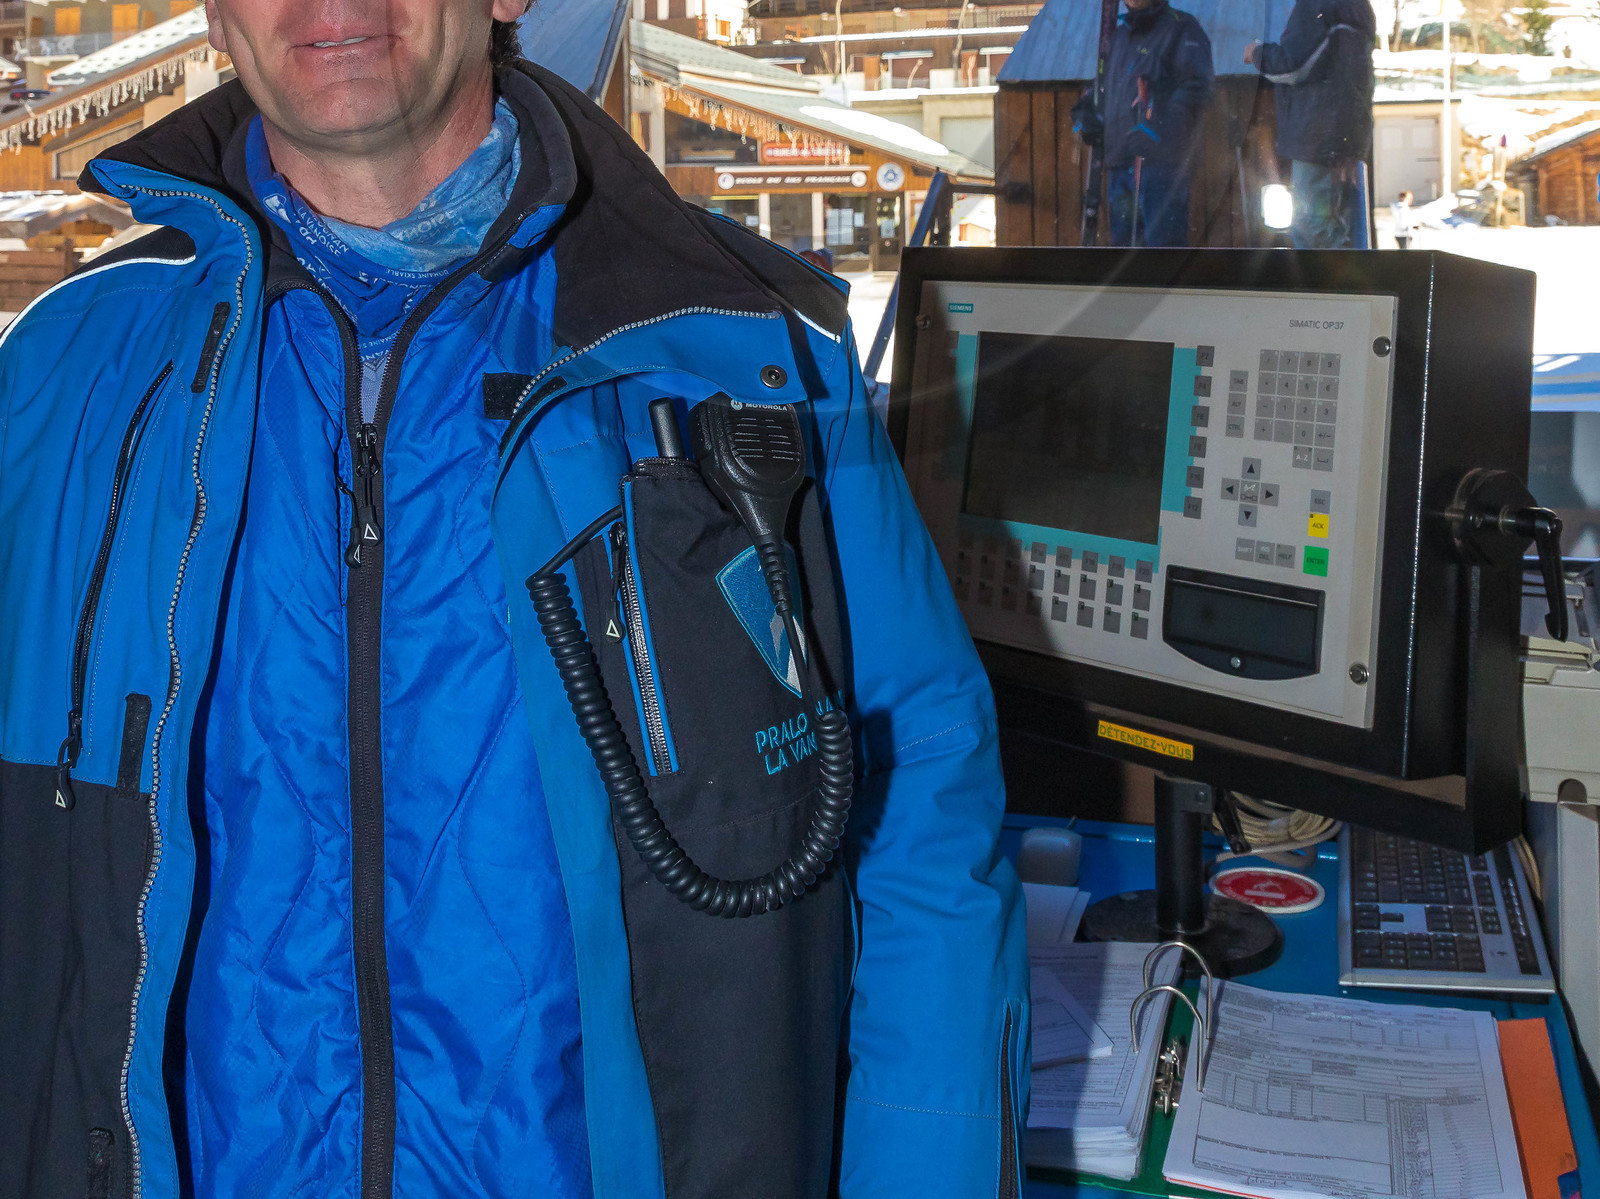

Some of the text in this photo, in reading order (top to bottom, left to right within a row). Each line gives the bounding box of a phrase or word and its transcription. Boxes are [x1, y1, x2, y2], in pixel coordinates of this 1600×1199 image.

[418, 269, 449, 279] DOMAINE
[1289, 319, 1320, 329] SIMATIC
[745, 402, 788, 411] MOTOROLA
[1098, 724, 1193, 761] DÉTENDEZ-VOUS
[765, 748, 789, 776] LA
